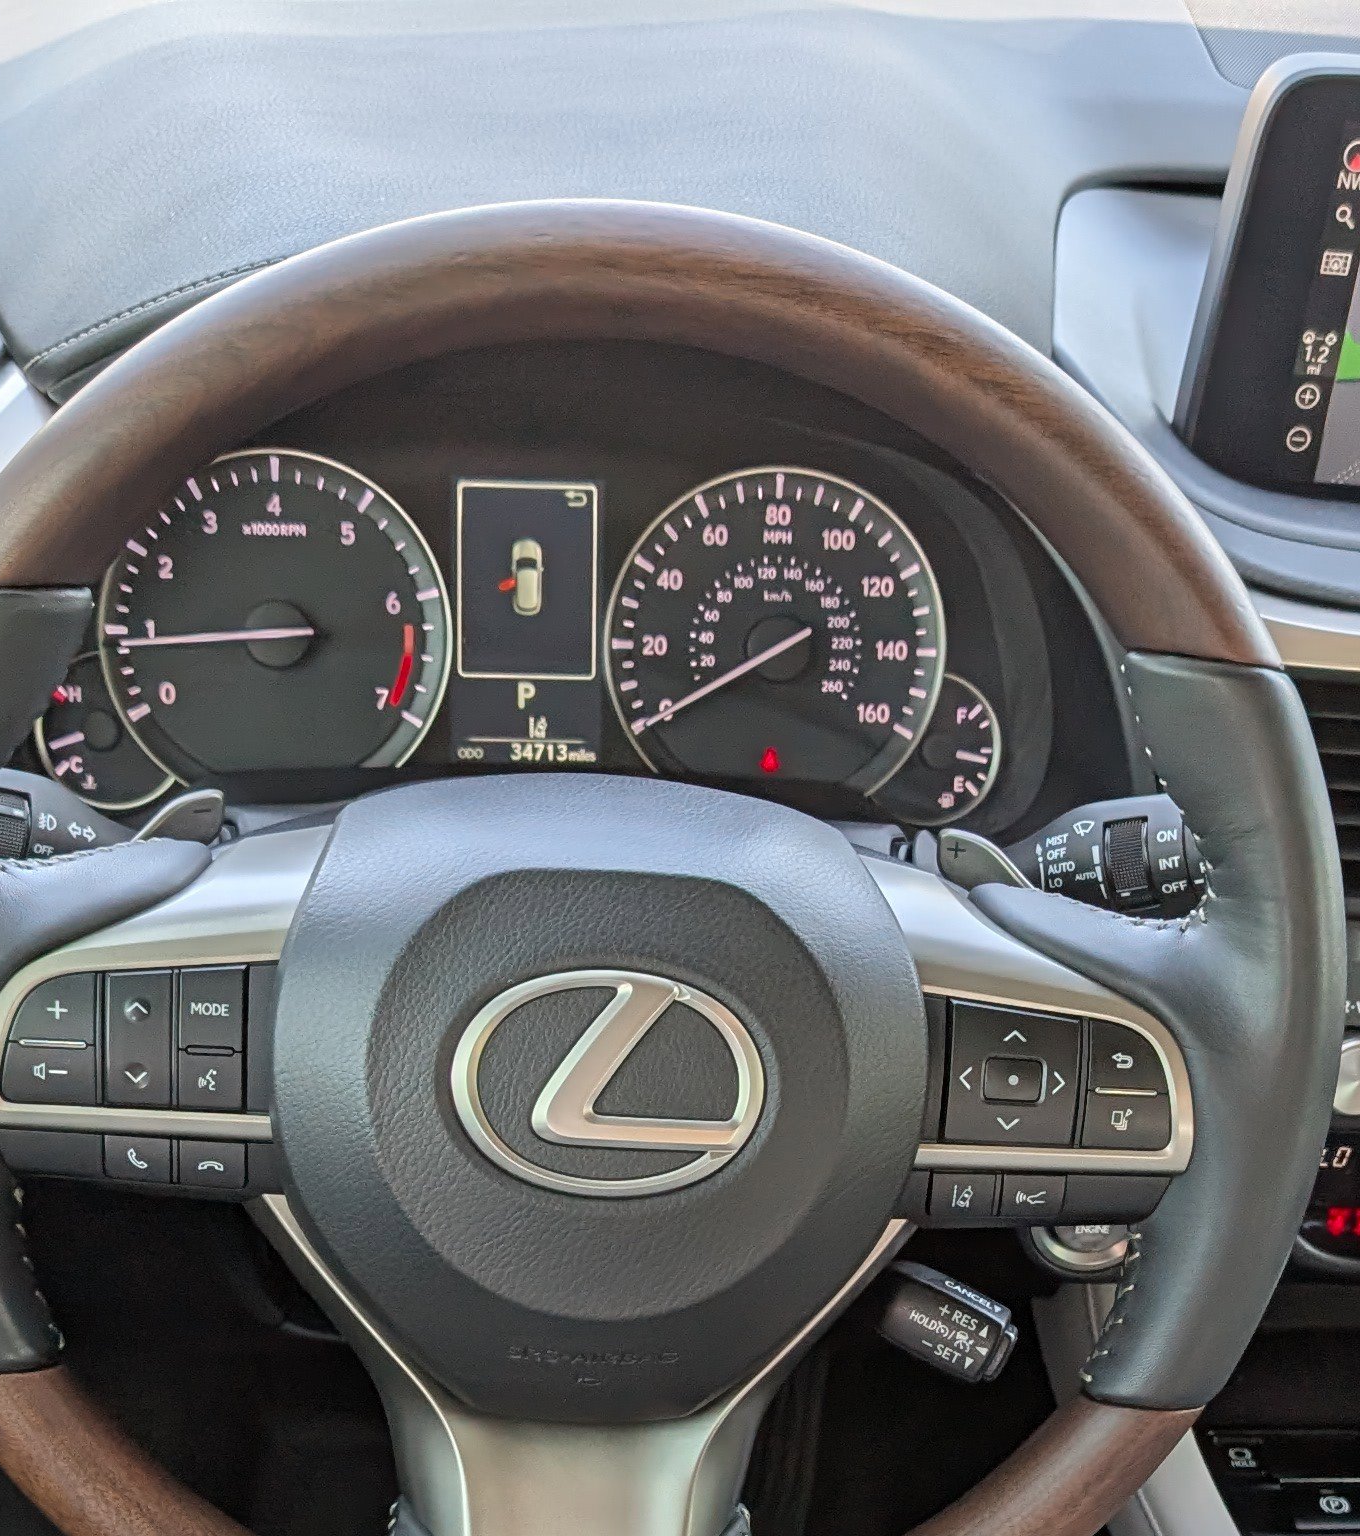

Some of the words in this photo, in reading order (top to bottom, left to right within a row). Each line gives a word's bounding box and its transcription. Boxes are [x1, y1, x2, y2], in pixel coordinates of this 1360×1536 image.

[1305, 346, 1330, 365] 1.2
[266, 493, 282, 516] 4
[202, 509, 218, 535] 3
[765, 503, 792, 526] 80
[339, 520, 356, 546] 5
[702, 524, 729, 547] 60
[763, 529, 793, 545] MPH
[821, 528, 856, 551] 100
[157, 554, 174, 580] 2
[758, 567, 777, 580] 120
[783, 567, 803, 581] 140
[656, 568, 683, 591] 40
[734, 576, 754, 589] 100
[805, 578, 825, 592] 160
[861, 575, 895, 598] 120
[385, 590, 401, 615] 6
[716, 589, 733, 604] 80
[763, 589, 793, 603] km/h
[820, 595, 840, 609] 180
[703, 609, 720, 623] 60
[827, 616, 850, 629] 200
[144, 619, 156, 639] 1
[698, 630, 715, 645] 40
[641, 633, 669, 656] 20
[831, 637, 854, 650] 220
[876, 639, 909, 662] 140
[700, 654, 716, 667] 20
[828, 658, 851, 672] 240
[67, 685, 83, 703] H
[158, 681, 177, 705] 0
[516, 681, 537, 709] P
[821, 680, 844, 693] 260
[374, 686, 390, 710] 7
[856, 703, 891, 724] 160
[956, 706, 968, 724] F
[509, 742, 569, 763] 34713
[69, 754, 84, 774] C
[953, 775, 965, 793] E
[1045, 832, 1070, 848] MIST
[1156, 828, 1178, 843] ON
[33, 844, 55, 856] OFF
[1046, 847, 1067, 861] OFF
[1047, 860, 1076, 876] AUTO
[1158, 855, 1182, 870] INT
[1048, 876, 1063, 889] LO
[1074, 870, 1097, 882] AUTO
[1161, 879, 1188, 894] OFF
[189, 1001, 231, 1017] MODE
[1074, 1224, 1111, 1235] ENGINE
[943, 1278, 994, 1311] CANCEL
[908, 1308, 937, 1330] HOLD
[951, 1310, 980, 1331] RES
[933, 1343, 962, 1364] SET
